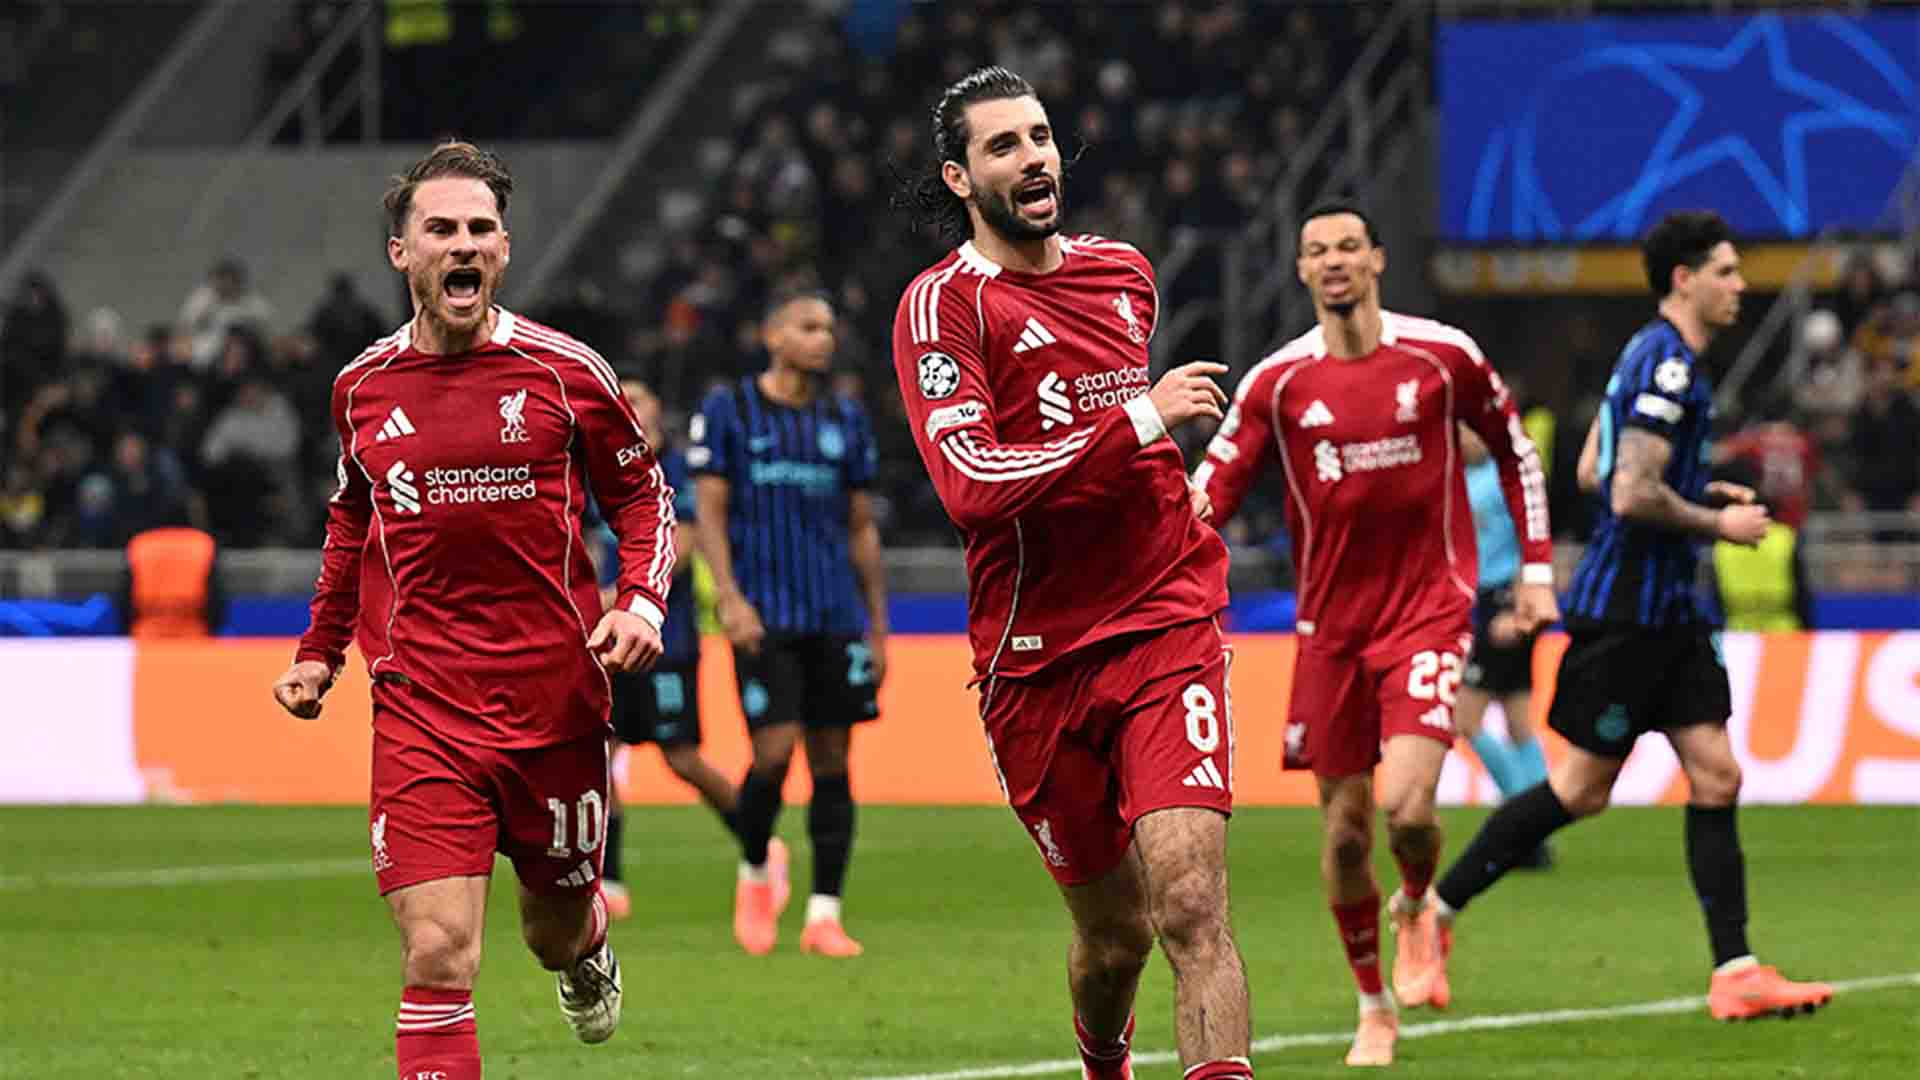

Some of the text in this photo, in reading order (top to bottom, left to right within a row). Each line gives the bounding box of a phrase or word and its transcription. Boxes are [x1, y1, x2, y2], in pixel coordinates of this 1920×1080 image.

[615, 442, 649, 467] Exp
[424, 463, 530, 486] standard
[426, 480, 537, 505] chartered
[1407, 650, 1462, 704] 22
[1182, 683, 1219, 752] 8
[547, 789, 604, 858] 10
